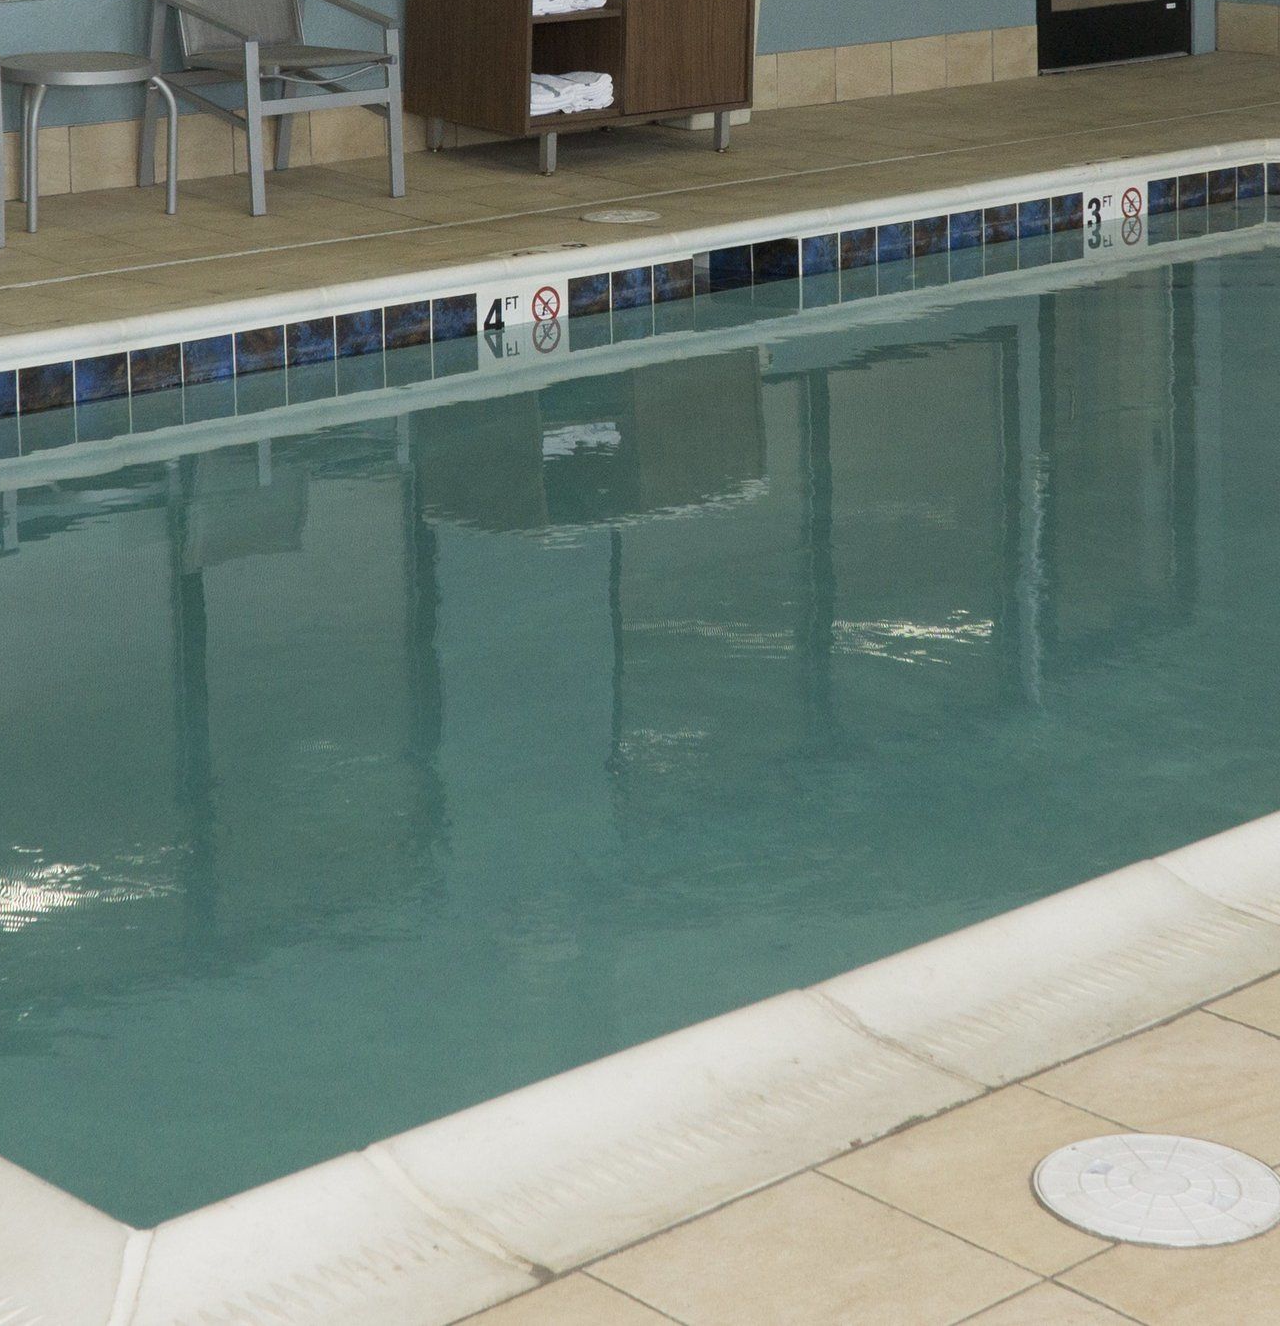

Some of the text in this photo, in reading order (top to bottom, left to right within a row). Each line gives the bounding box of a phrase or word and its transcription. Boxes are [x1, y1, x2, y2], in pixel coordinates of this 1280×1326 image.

[1088, 196, 1112, 225] 3 FT
[484, 296, 518, 330] 4 FT
